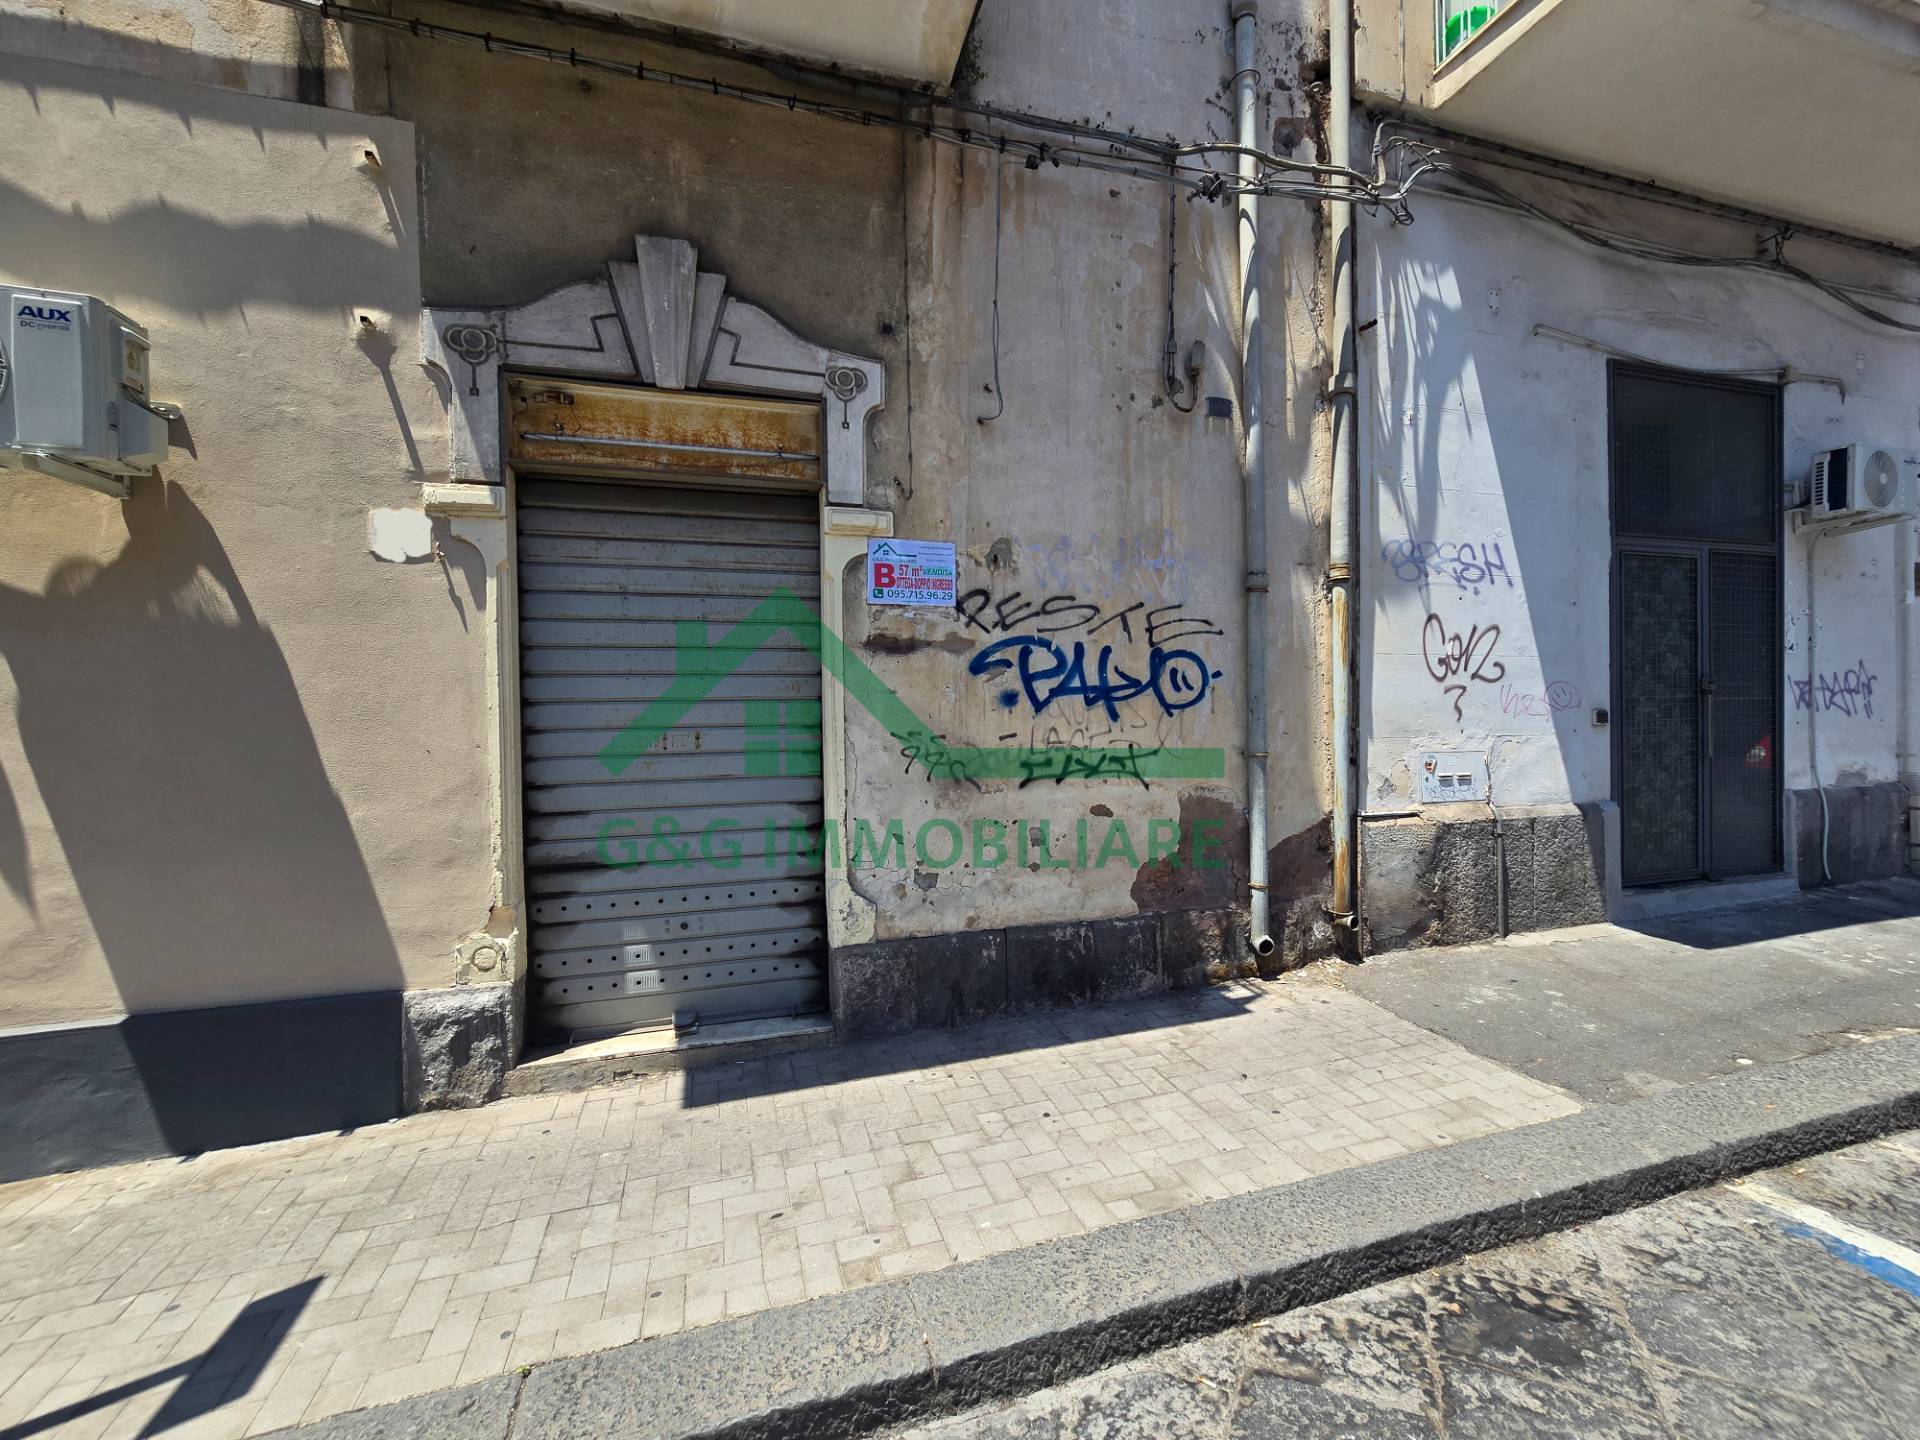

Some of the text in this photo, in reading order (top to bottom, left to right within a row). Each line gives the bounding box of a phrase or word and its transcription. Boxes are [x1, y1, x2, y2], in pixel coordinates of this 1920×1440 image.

[17, 305, 72, 323] AUX
[874, 563, 896, 588] B
[899, 564, 909, 576] 57
[923, 567, 953, 576] VENDITA
[887, 589, 953, 600] 095.715.96.29
